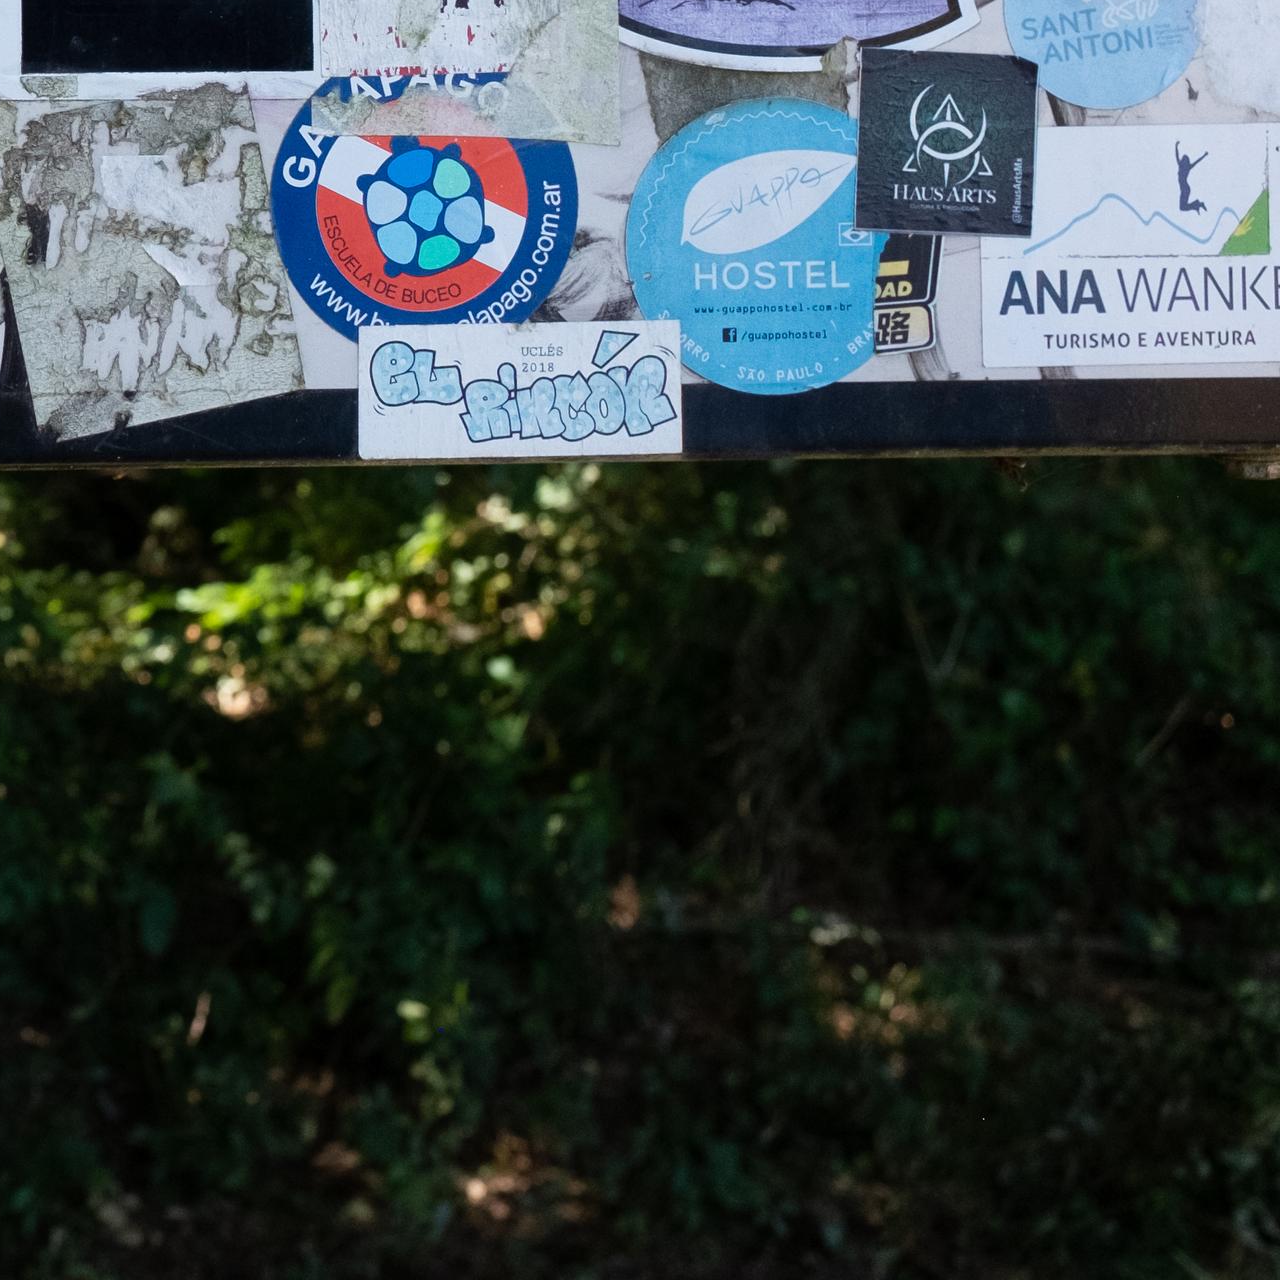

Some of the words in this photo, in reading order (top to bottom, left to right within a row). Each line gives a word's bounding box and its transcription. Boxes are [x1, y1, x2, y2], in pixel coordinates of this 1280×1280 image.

[1021, 9, 1097, 41] SANT
[1044, 25, 1154, 65] ANTONI
[893, 183, 944, 201] HAUS
[945, 185, 997, 204] ARTS
[324, 214, 373, 290] ESCUELA
[373, 279, 397, 300] DE
[401, 283, 462, 304] BUCEO
[694, 259, 851, 291] HOSTEL
[999, 267, 1106, 316] ANA
[693, 302, 853, 315] www.guappohostel.com.br
[740, 329, 828, 342] /guappohostel
[1043, 332, 1131, 350] TURISMO
[1139, 331, 1148, 347] E
[1153, 329, 1257, 348] AVENTURA
[521, 344, 564, 357] UCLÉS
[521, 362, 555, 373] 2018
[776, 361, 824, 382] PAULO
